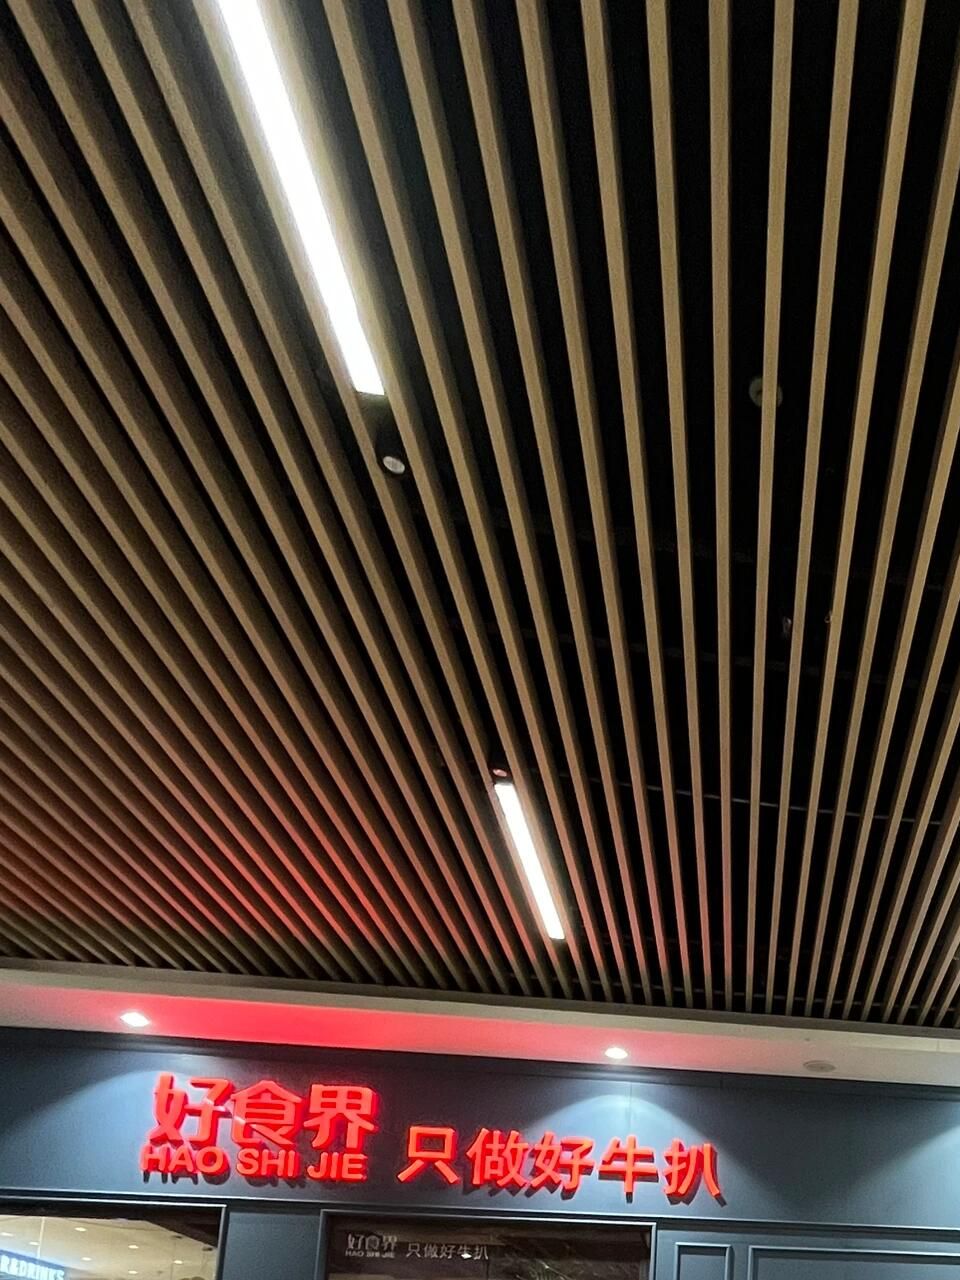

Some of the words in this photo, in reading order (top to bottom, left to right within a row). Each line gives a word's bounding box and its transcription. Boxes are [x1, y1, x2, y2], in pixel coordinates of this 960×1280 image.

[147, 1071, 379, 1150] 好食界
[140, 1145, 229, 1175] HAO
[236, 1147, 301, 1180] SHI
[306, 1150, 369, 1181] JIE
[397, 1125, 722, 1198] 只做好牛扒
[347, 1233, 397, 1250] 好食界
[406, 1243, 489, 1260] 只做好牛扒
